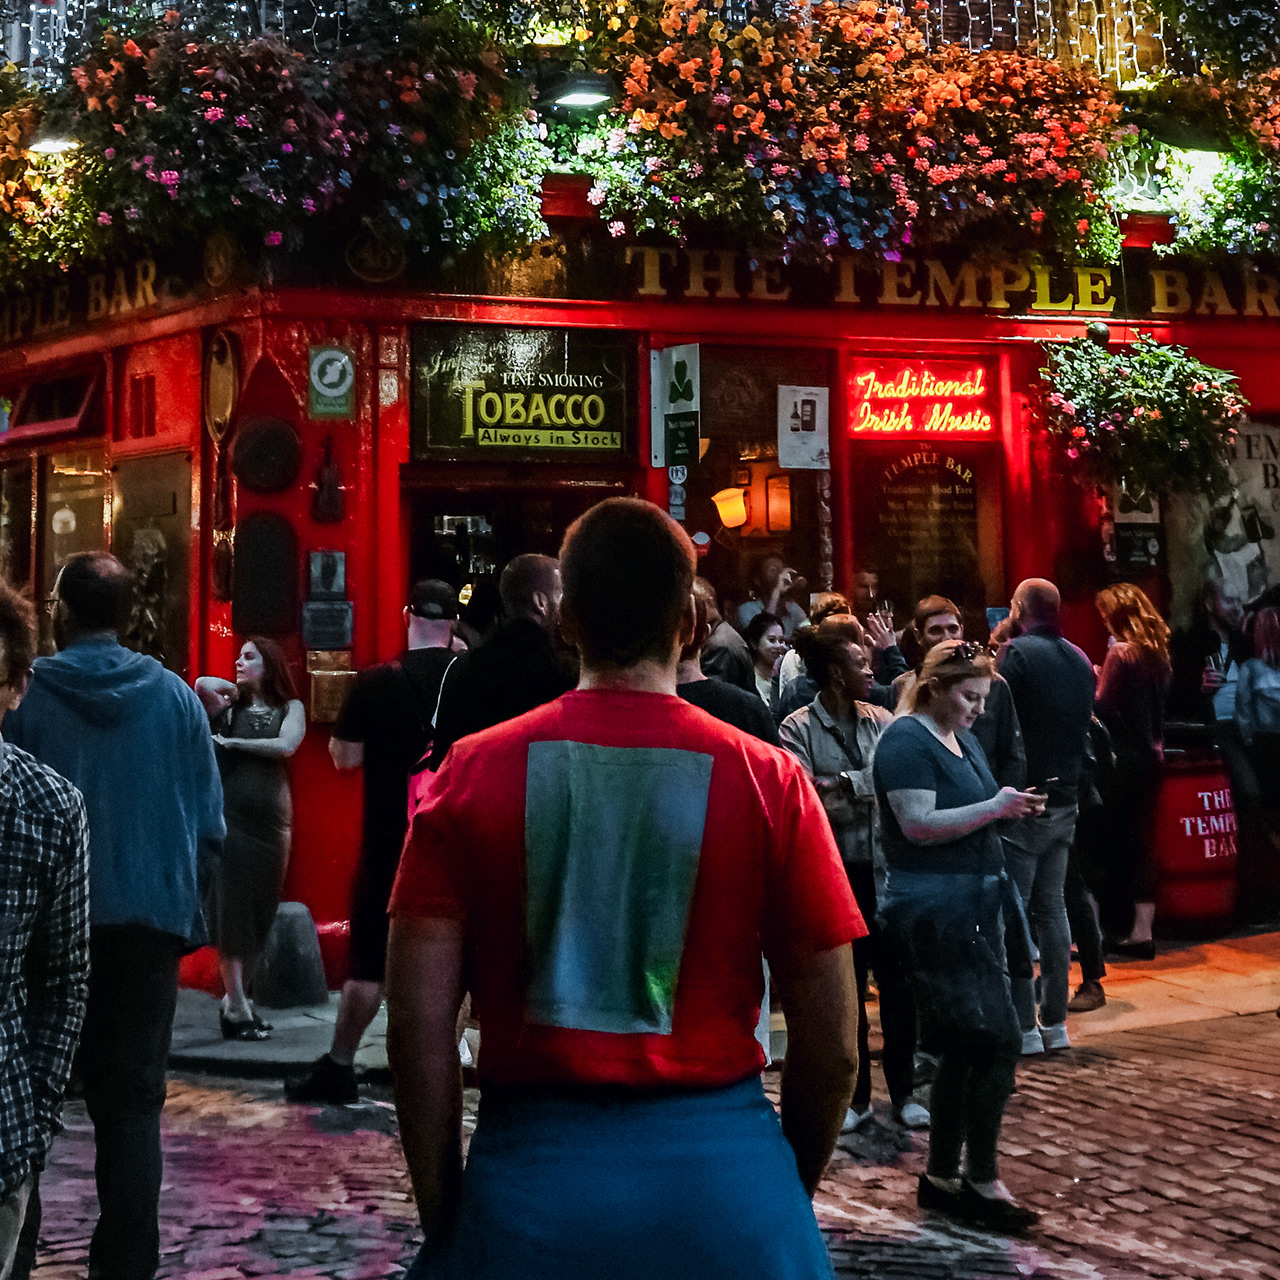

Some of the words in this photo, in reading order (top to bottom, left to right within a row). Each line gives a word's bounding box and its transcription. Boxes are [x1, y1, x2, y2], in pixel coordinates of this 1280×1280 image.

[86, 257, 158, 322] BAR
[624, 245, 792, 301] THE
[833, 254, 1116, 313] TEMPLE
[537, 373, 604, 389] SMOKING
[856, 368, 985, 400] Traditional
[459, 378, 606, 439] TOBACCO
[853, 401, 913, 432] Irish
[924, 402, 992, 432] Music
[480, 429, 541, 446] Always
[549, 436, 565, 447] in
[571, 429, 620, 447] Stock
[883, 451, 941, 481] TEMPLE
[945, 456, 973, 484] BAR
